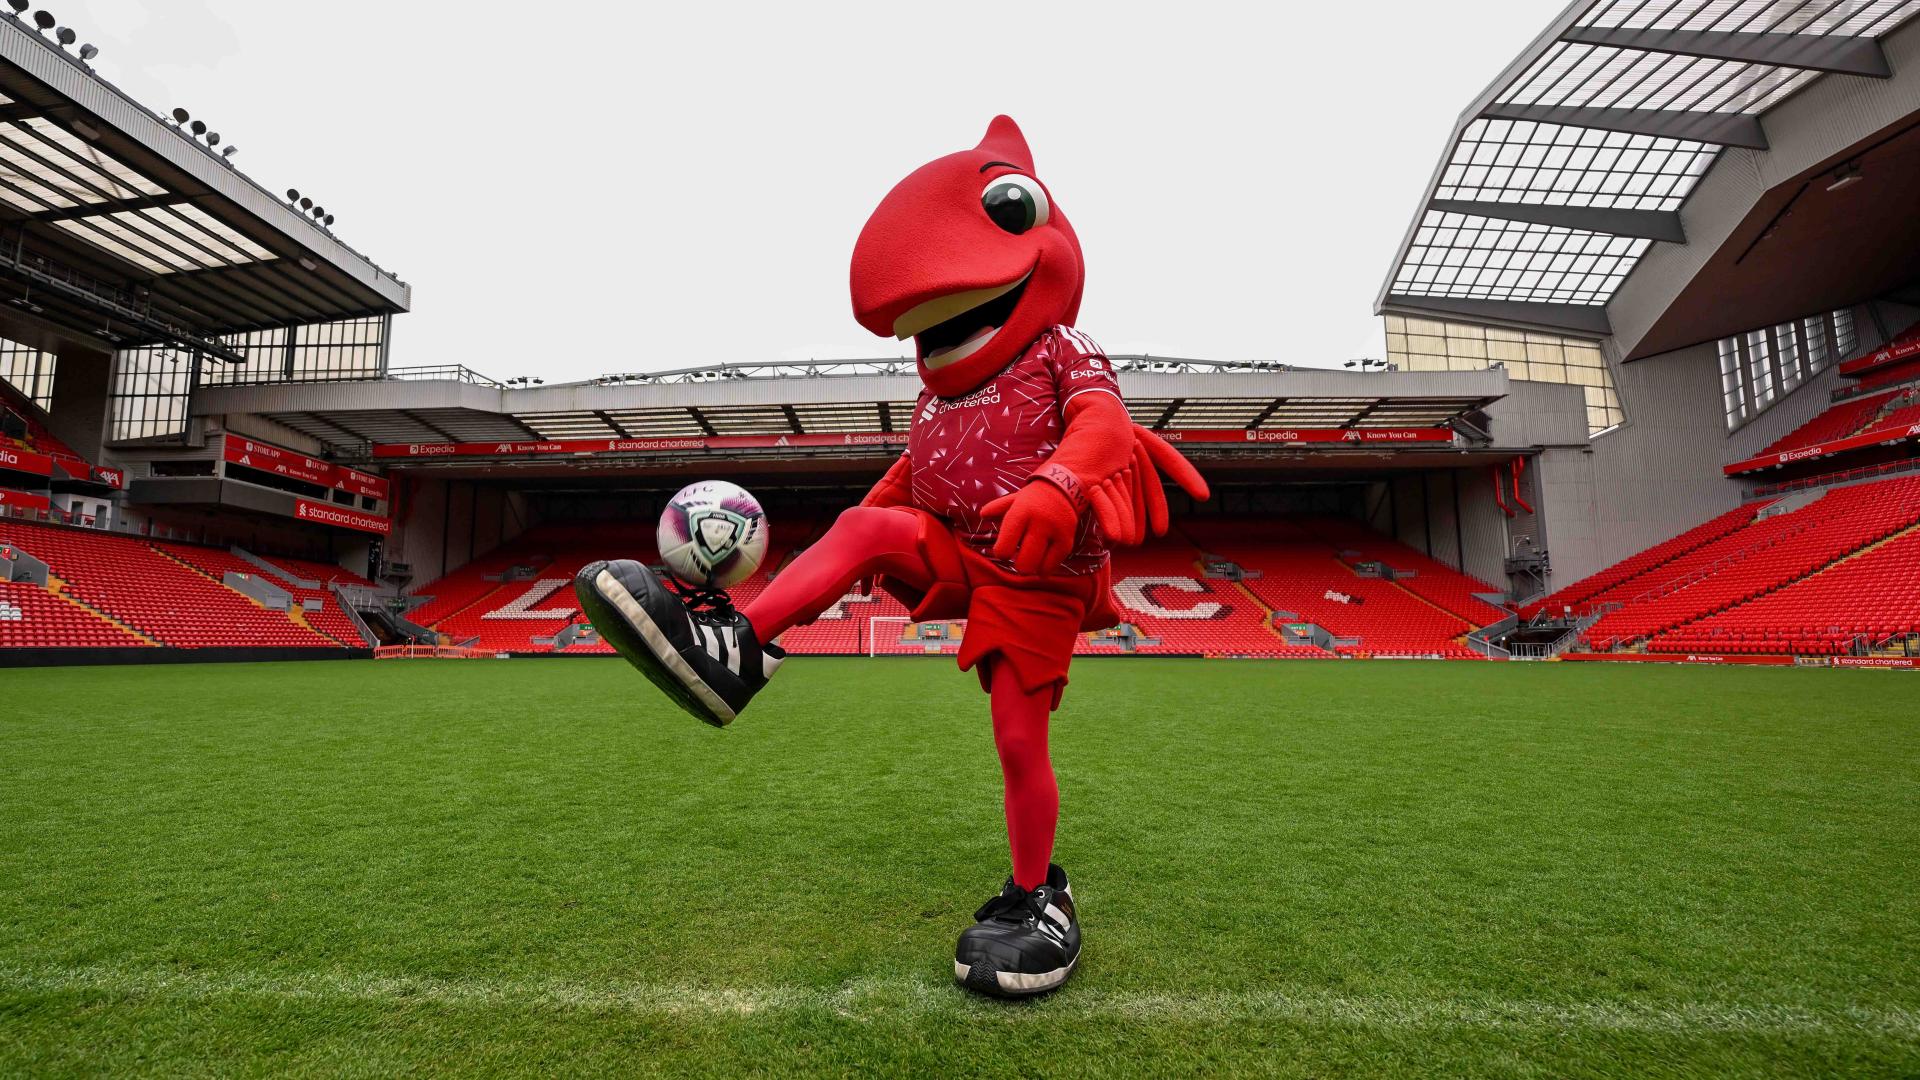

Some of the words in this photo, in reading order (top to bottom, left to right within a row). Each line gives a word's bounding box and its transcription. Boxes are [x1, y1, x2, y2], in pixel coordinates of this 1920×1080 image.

[1873, 351, 1891, 363] AXA
[939, 393, 1001, 414] chartered
[854, 434, 896, 443] standard
[1258, 431, 1297, 441] Expedia
[1341, 431, 1361, 440] AXA
[495, 443, 513, 453] AXA
[618, 440, 658, 449] standard
[660, 439, 704, 448] chartered
[421, 444, 455, 455] Expedia
[1789, 448, 1821, 459] Expedia
[100, 471, 119, 485] AXA
[309, 507, 350, 523] standard
[351, 516, 389, 531] chartered
[1875, 658, 1912, 666] chartered
